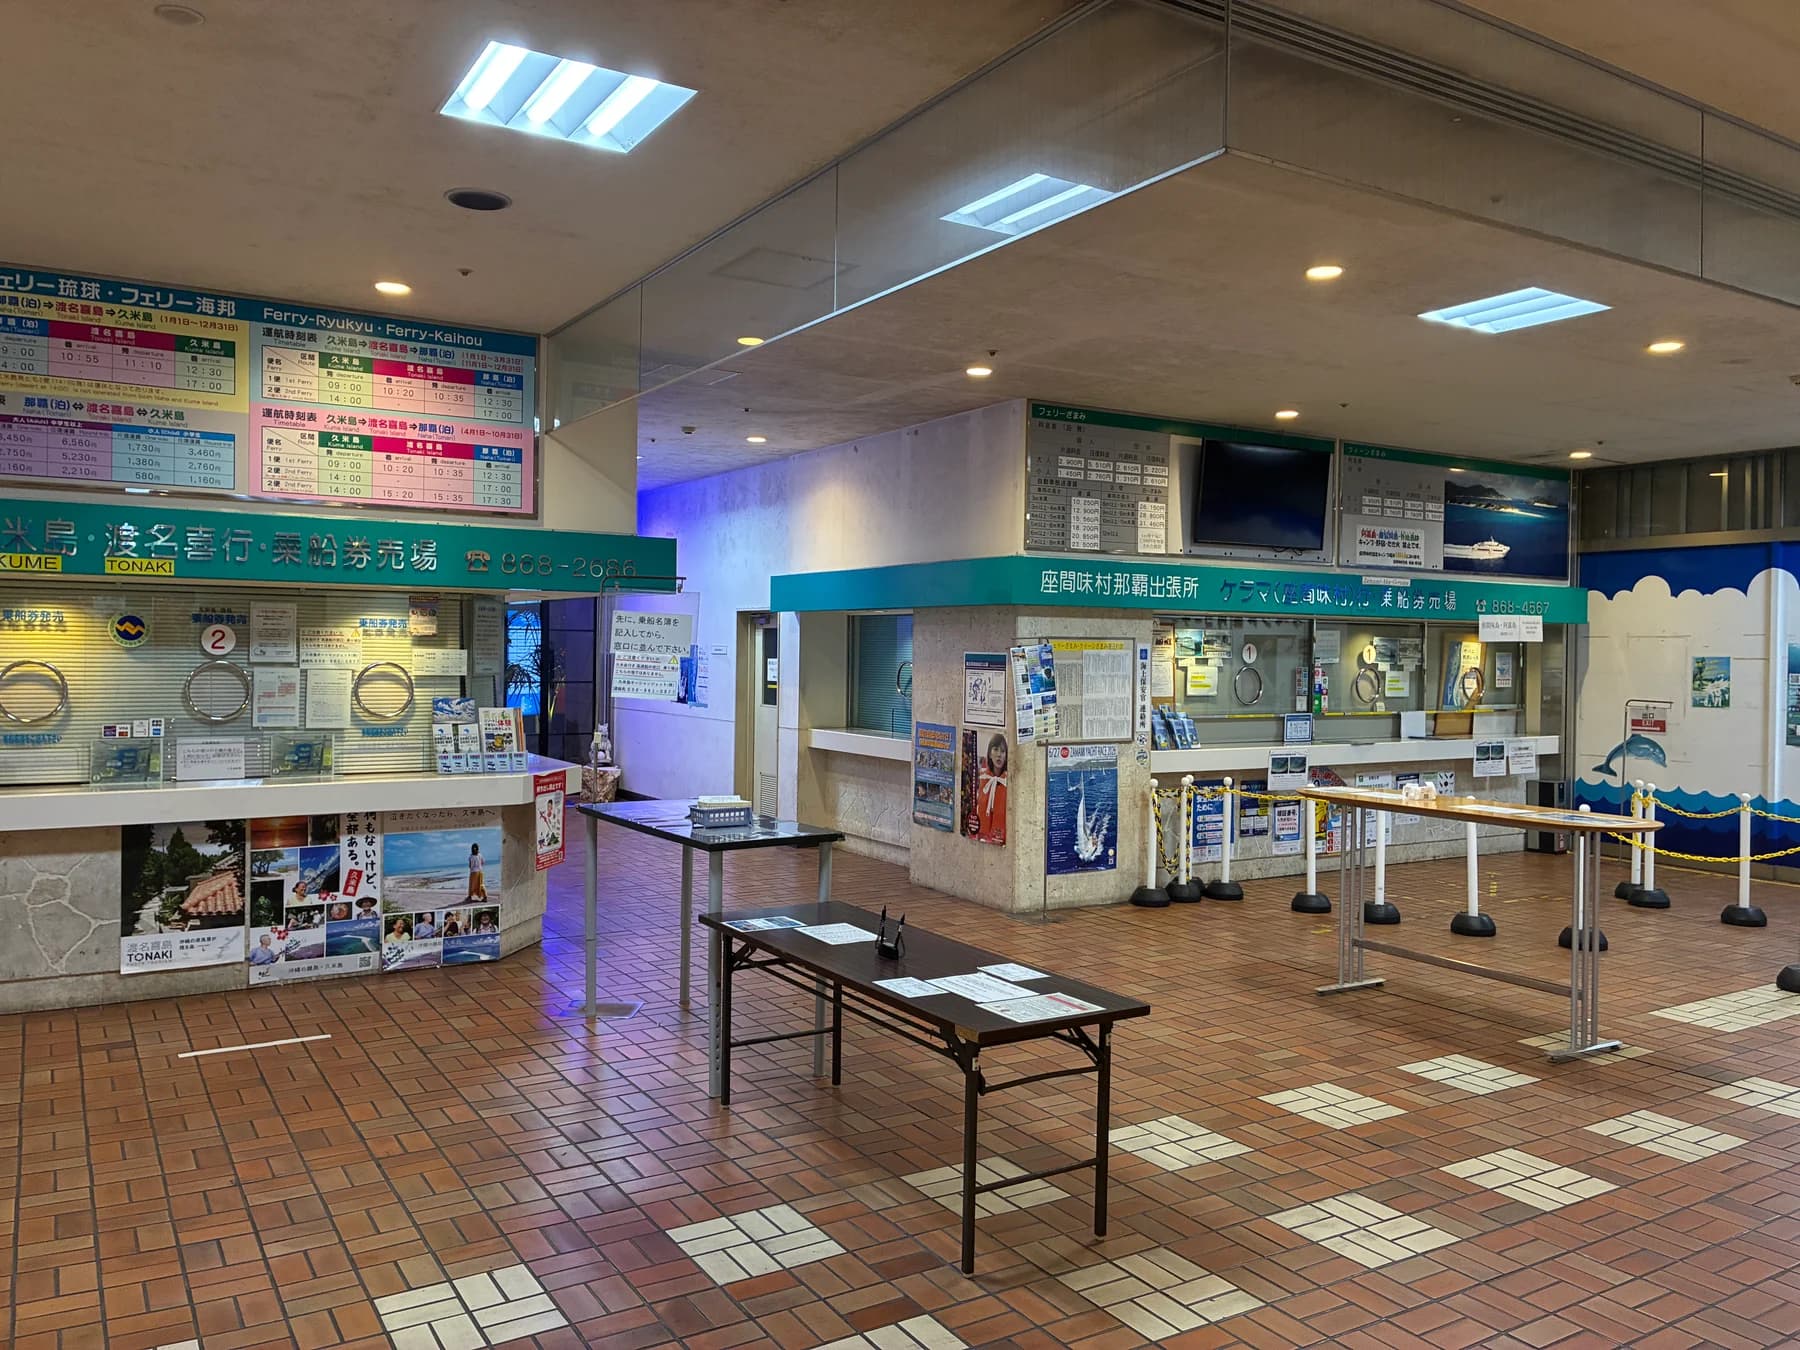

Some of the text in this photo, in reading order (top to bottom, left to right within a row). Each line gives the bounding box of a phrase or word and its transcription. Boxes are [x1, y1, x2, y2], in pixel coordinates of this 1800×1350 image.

[118, 309, 153, 324] 久米島
[262, 327, 318, 344] 運航時刻表
[327, 334, 358, 348] 久米島
[61, 352, 99, 364] 10:55
[125, 358, 162, 371] 11:10
[187, 365, 222, 377] 12:30
[187, 379, 222, 391] 17:00
[328, 381, 361, 392] 09:00
[383, 387, 414, 398] 10:20
[434, 392, 464, 403] 10:35
[330, 394, 361, 405] 14:00
[483, 398, 512, 408] 12:30
[150, 408, 185, 421] 久米島
[483, 410, 512, 420] 17:00
[1039, 407, 1086, 421] フェリーざまみ
[262, 408, 318, 423] 運航時刻表
[326, 414, 357, 427] 久米島
[367, 418, 408, 433] 渡名喜島
[418, 423, 454, 435] 那覇(泊)
[328, 460, 361, 470] 09:00
[383, 464, 414, 475] 10:20
[329, 473, 361, 484] 14:00
[434, 468, 463, 479] 10:35
[483, 472, 512, 481] 12:30
[329, 486, 361, 496] 14:00
[483, 484, 512, 494] 17:00
[383, 490, 414, 500] 15:20
[434, 493, 463, 503] 15:35
[483, 497, 512, 507] 17:30
[106, 559, 173, 575] TONAKI
[501, 551, 638, 579] 868-2686
[1040, 569, 1199, 599] 座間味村那覇出張所
[1491, 600, 1550, 617] 868-4567
[211, 629, 225, 650] 2
[613, 640, 689, 654] 窓口に並んで下さい。
[1642, 719, 1655, 728] EXIT
[346, 812, 360, 867] 全部ある。
[127, 950, 173, 963] TONAKI
